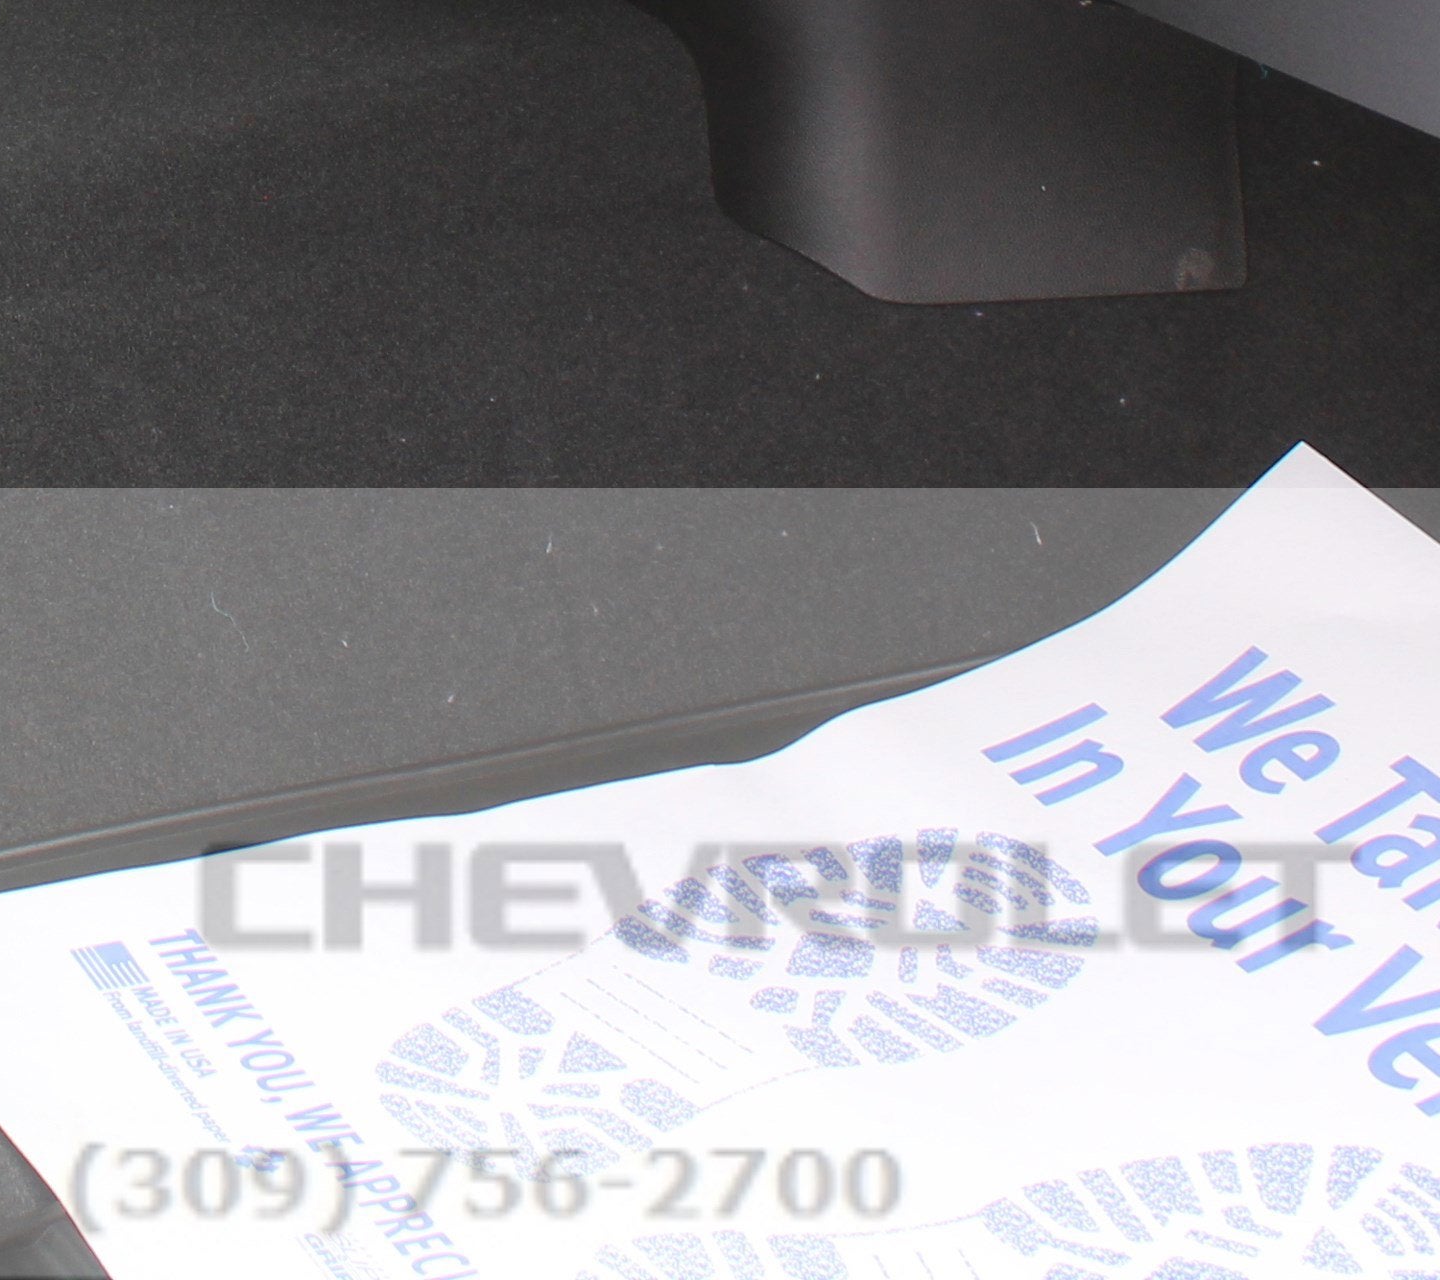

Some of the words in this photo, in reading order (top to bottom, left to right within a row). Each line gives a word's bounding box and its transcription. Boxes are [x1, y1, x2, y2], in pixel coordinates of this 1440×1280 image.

[1159, 645, 1341, 795] We
[980, 702, 1124, 806] In
[1093, 772, 1355, 974] Your
[131, 986, 178, 1026] MADE
[164, 1030, 193, 1046] IN
[180, 1048, 218, 1078] USA
[148, 928, 263, 1028] THANK
[228, 1028, 315, 1104] YOU,
[285, 1103, 364, 1152] WE
